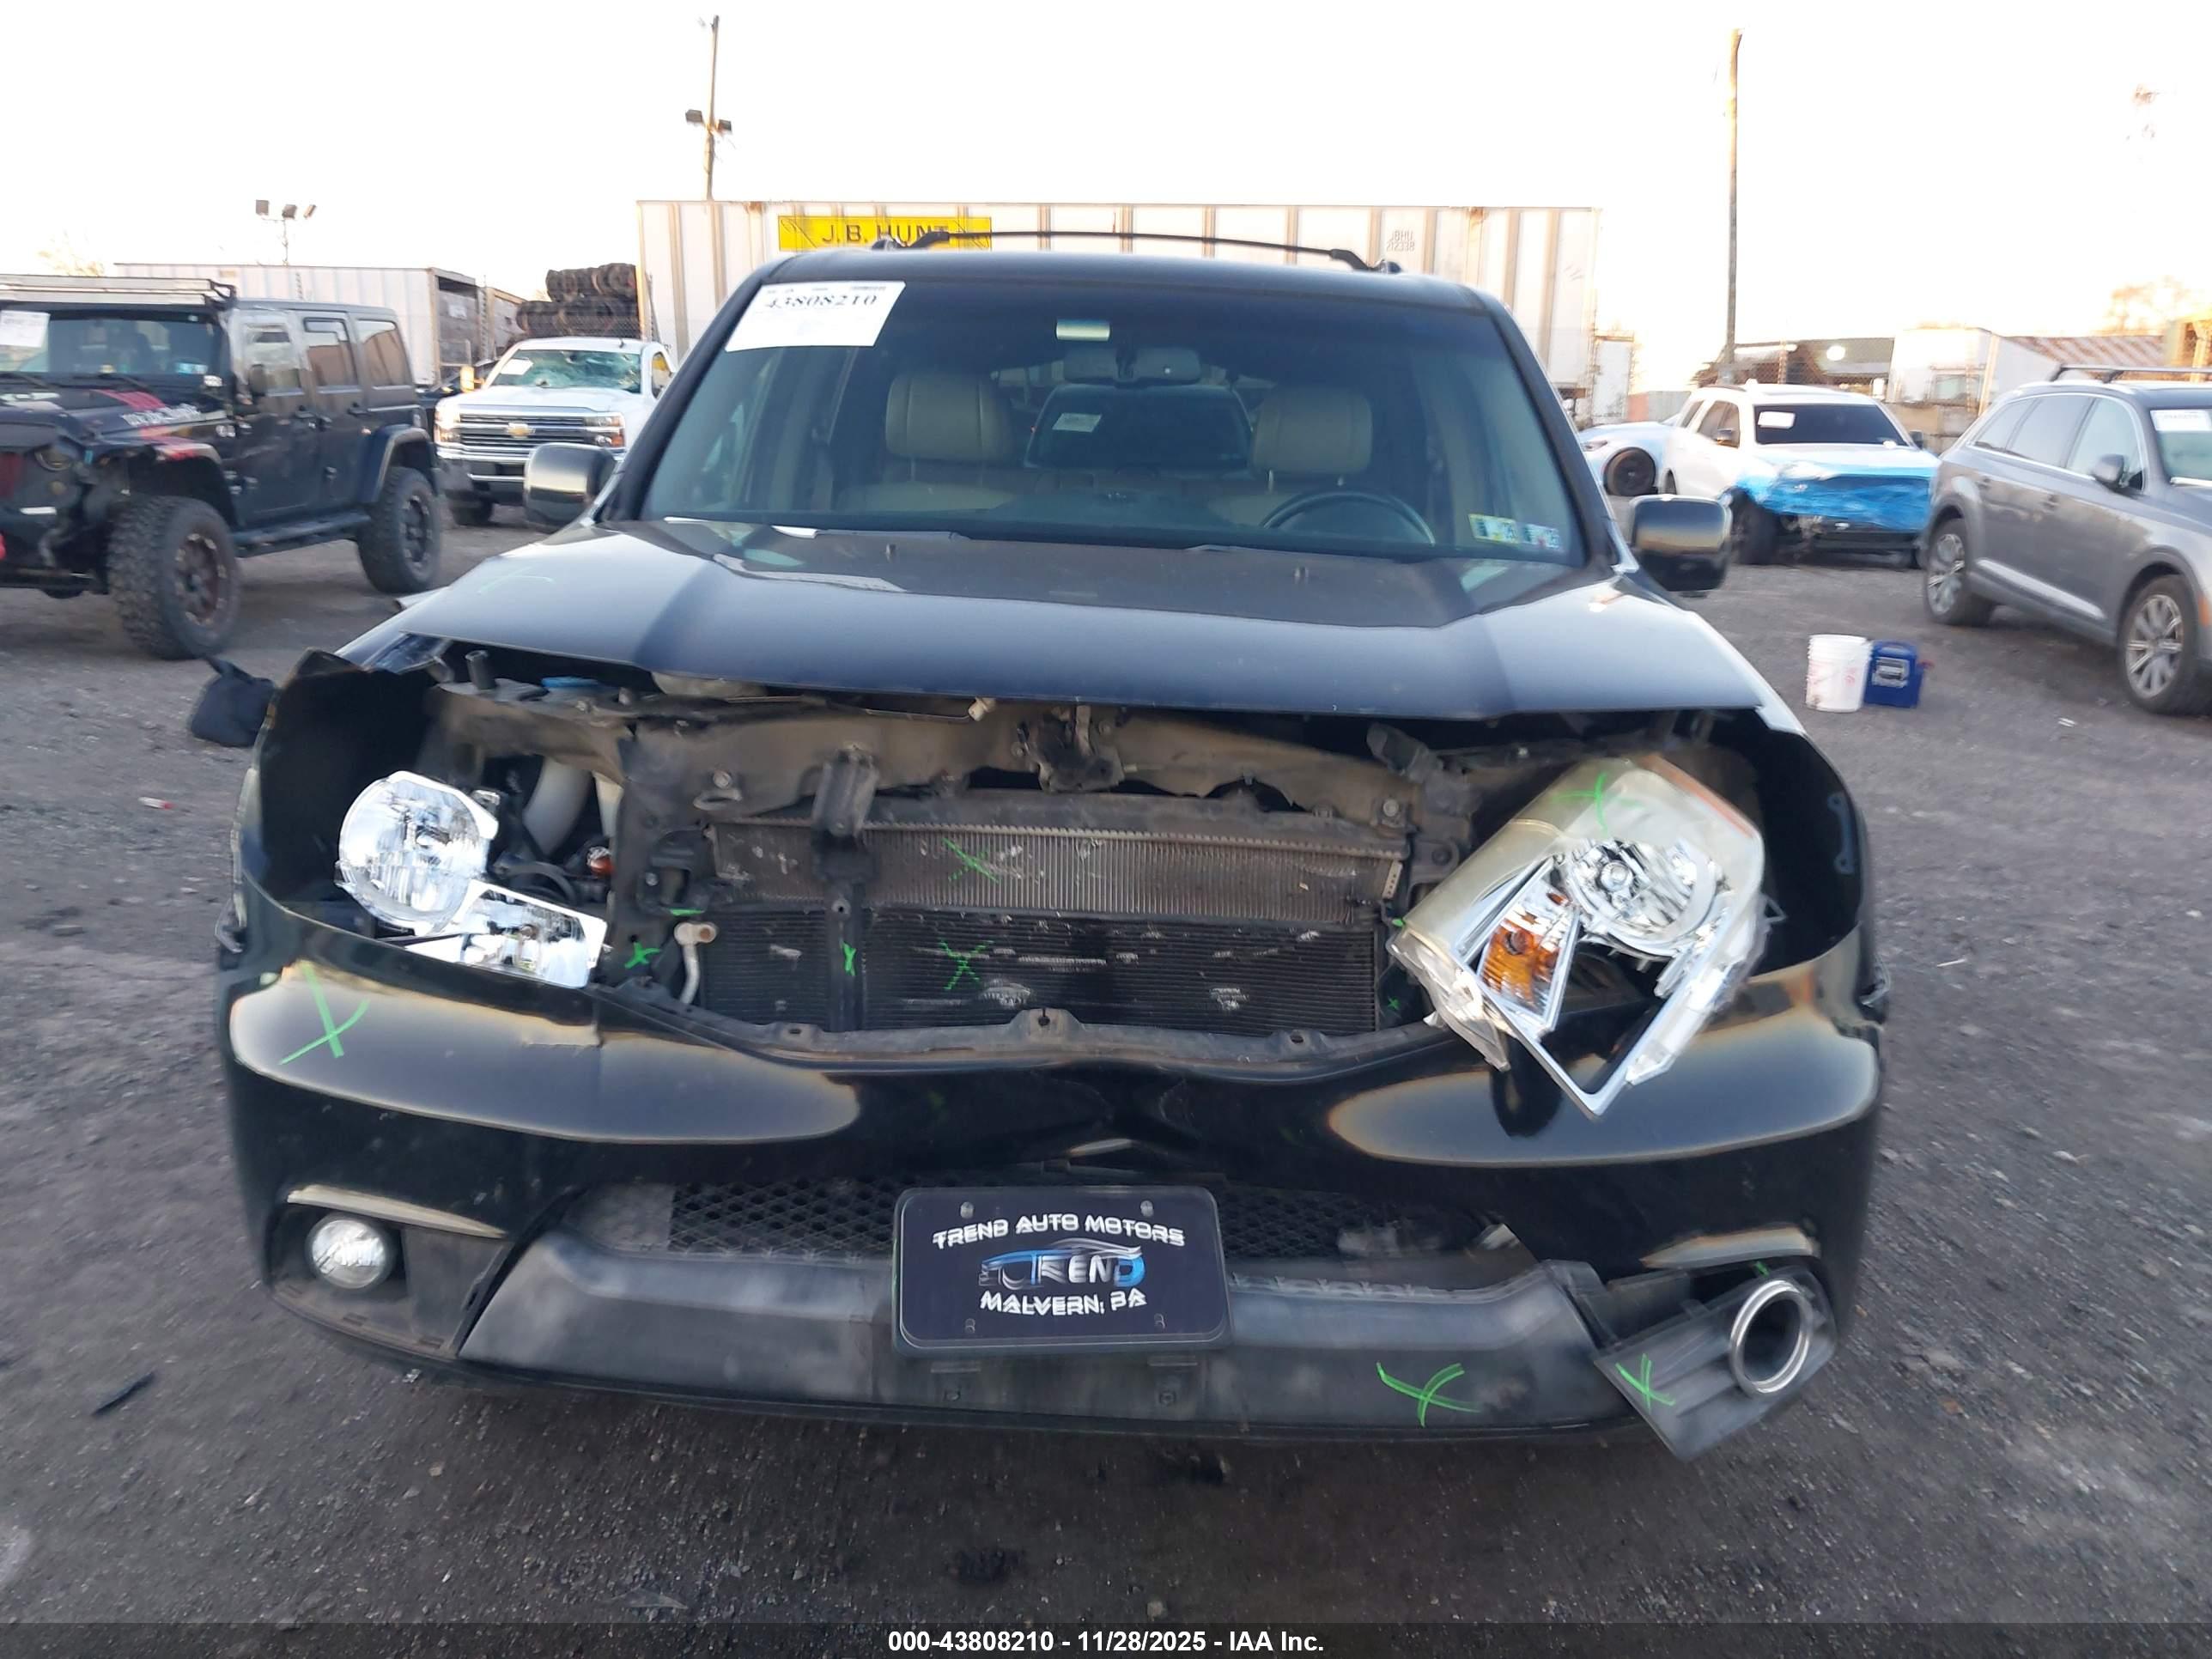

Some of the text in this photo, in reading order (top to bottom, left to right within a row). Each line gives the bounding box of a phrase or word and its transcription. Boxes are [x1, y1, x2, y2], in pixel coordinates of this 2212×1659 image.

[877, 225, 948, 244] HUN
[932, 1212, 1185, 1249] TREND AUTO MOTORS
[1110, 1287, 1147, 1311] PA
